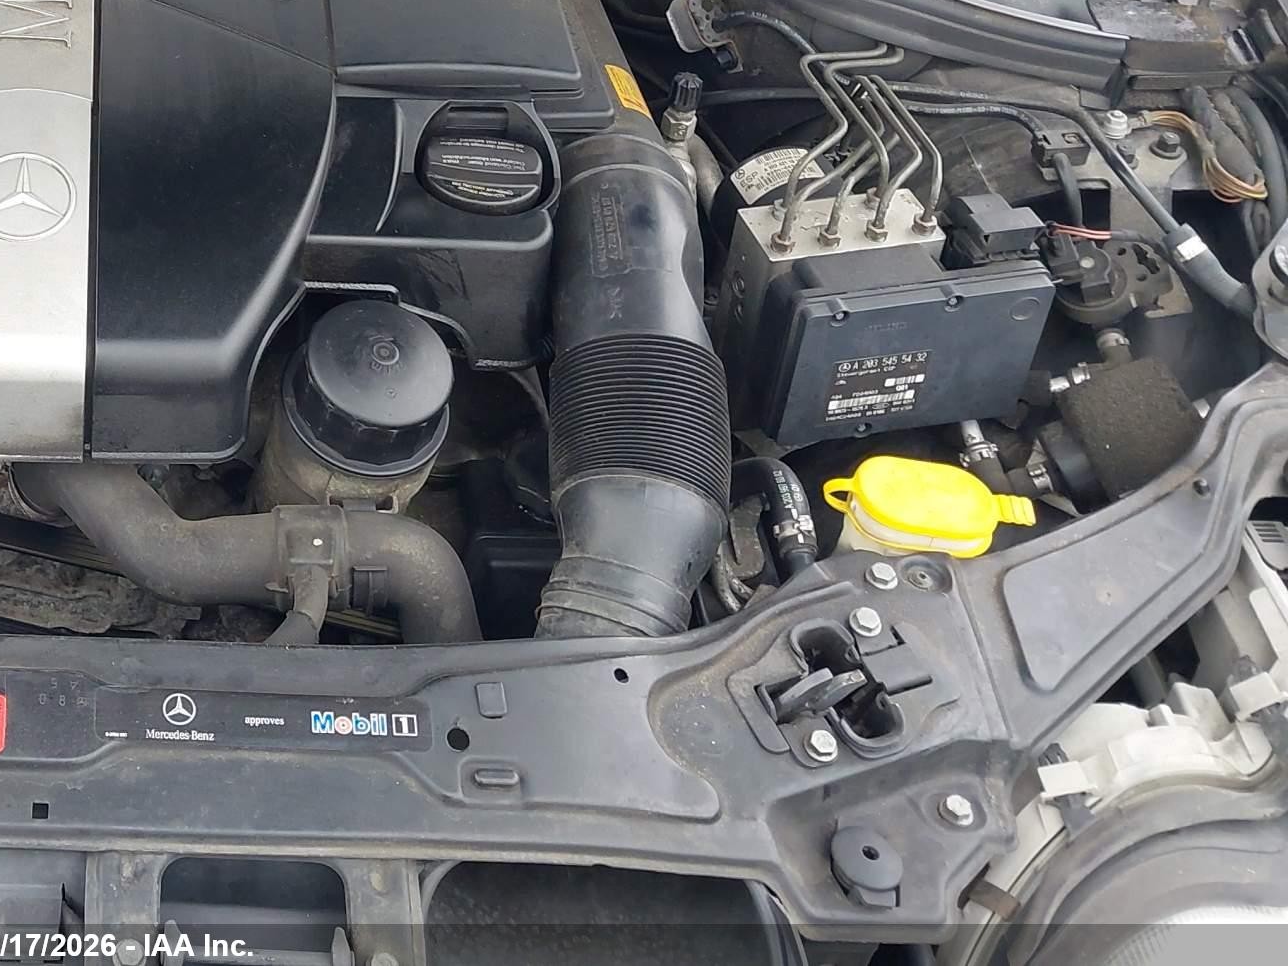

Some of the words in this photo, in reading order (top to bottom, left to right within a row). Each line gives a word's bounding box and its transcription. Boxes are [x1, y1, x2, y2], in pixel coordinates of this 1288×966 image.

[244, 715, 285, 726] approves
[311, 711, 388, 736] Mobil
[145, 728, 215, 742] Mercedes-Benz
